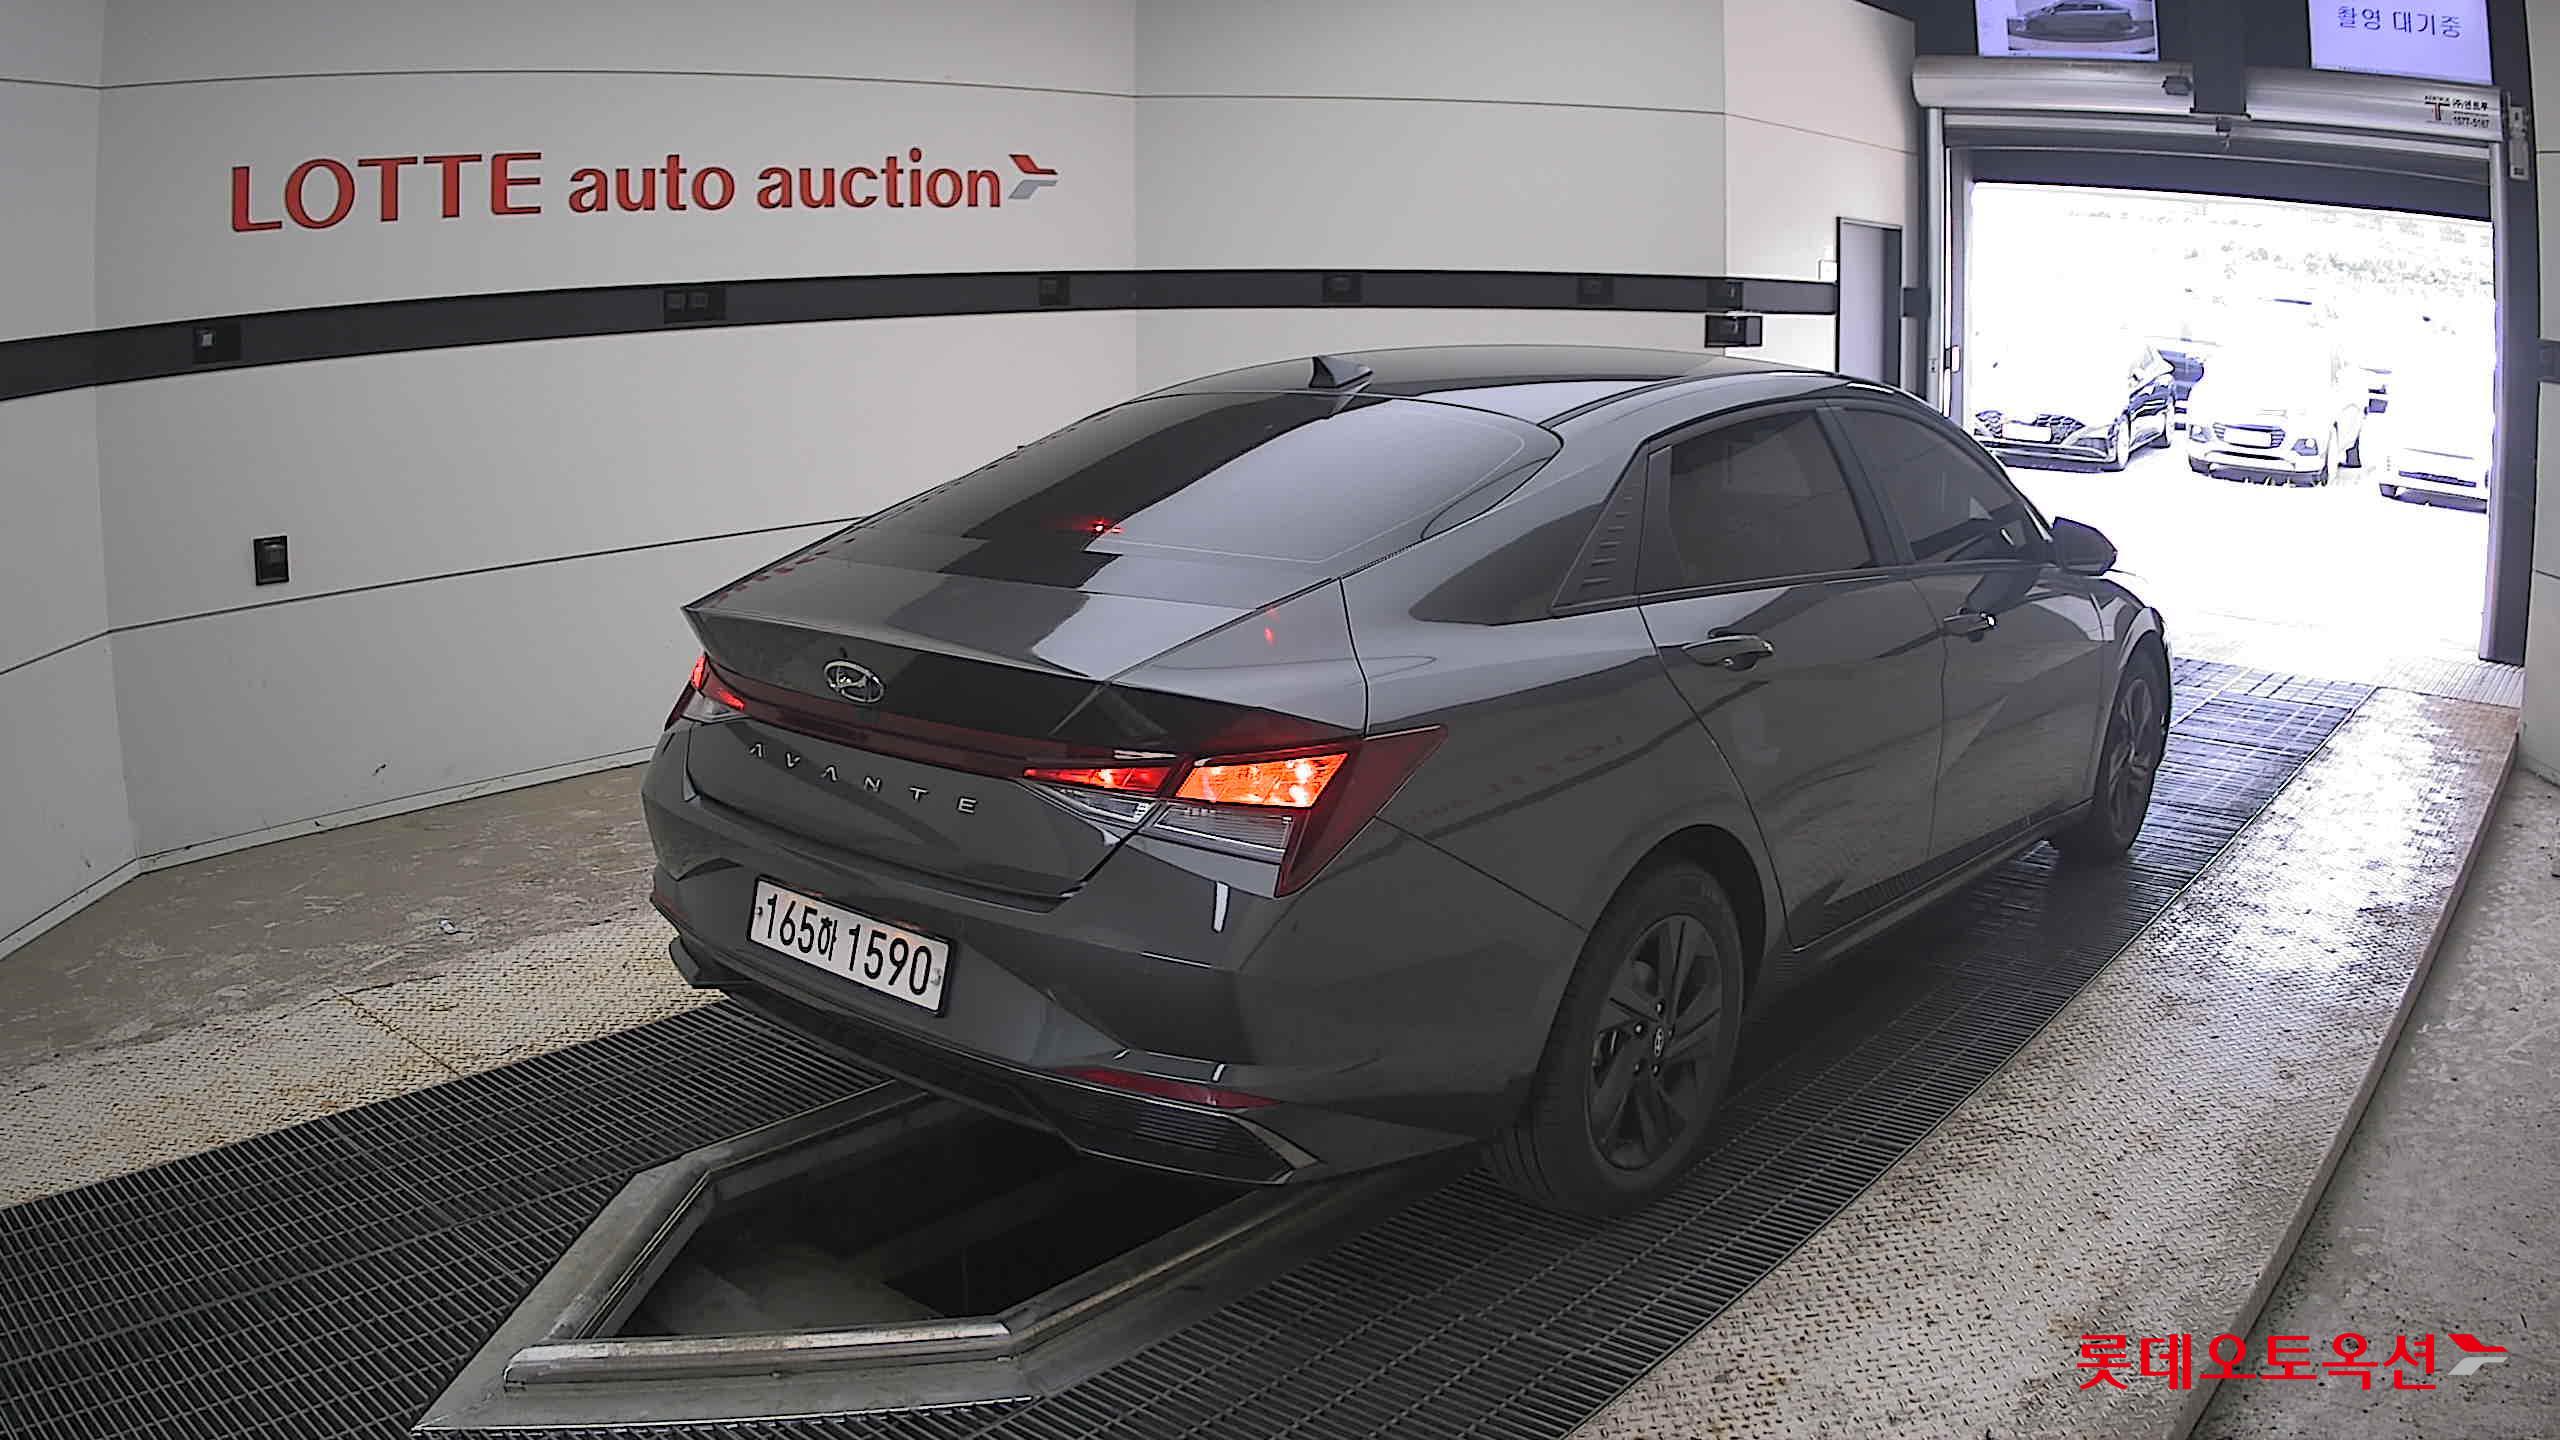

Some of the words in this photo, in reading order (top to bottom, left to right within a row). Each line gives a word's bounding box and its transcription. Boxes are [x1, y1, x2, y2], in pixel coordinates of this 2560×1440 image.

[2337, 5, 2382, 31] 촬영
[2392, 10, 2463, 39] 대기중
[230, 151, 543, 233] LOTTE
[568, 153, 736, 213] auto
[757, 146, 1002, 209] auction
[748, 742, 978, 814] AVANTE
[767, 894, 838, 962] 165하
[848, 923, 932, 996] 1590
